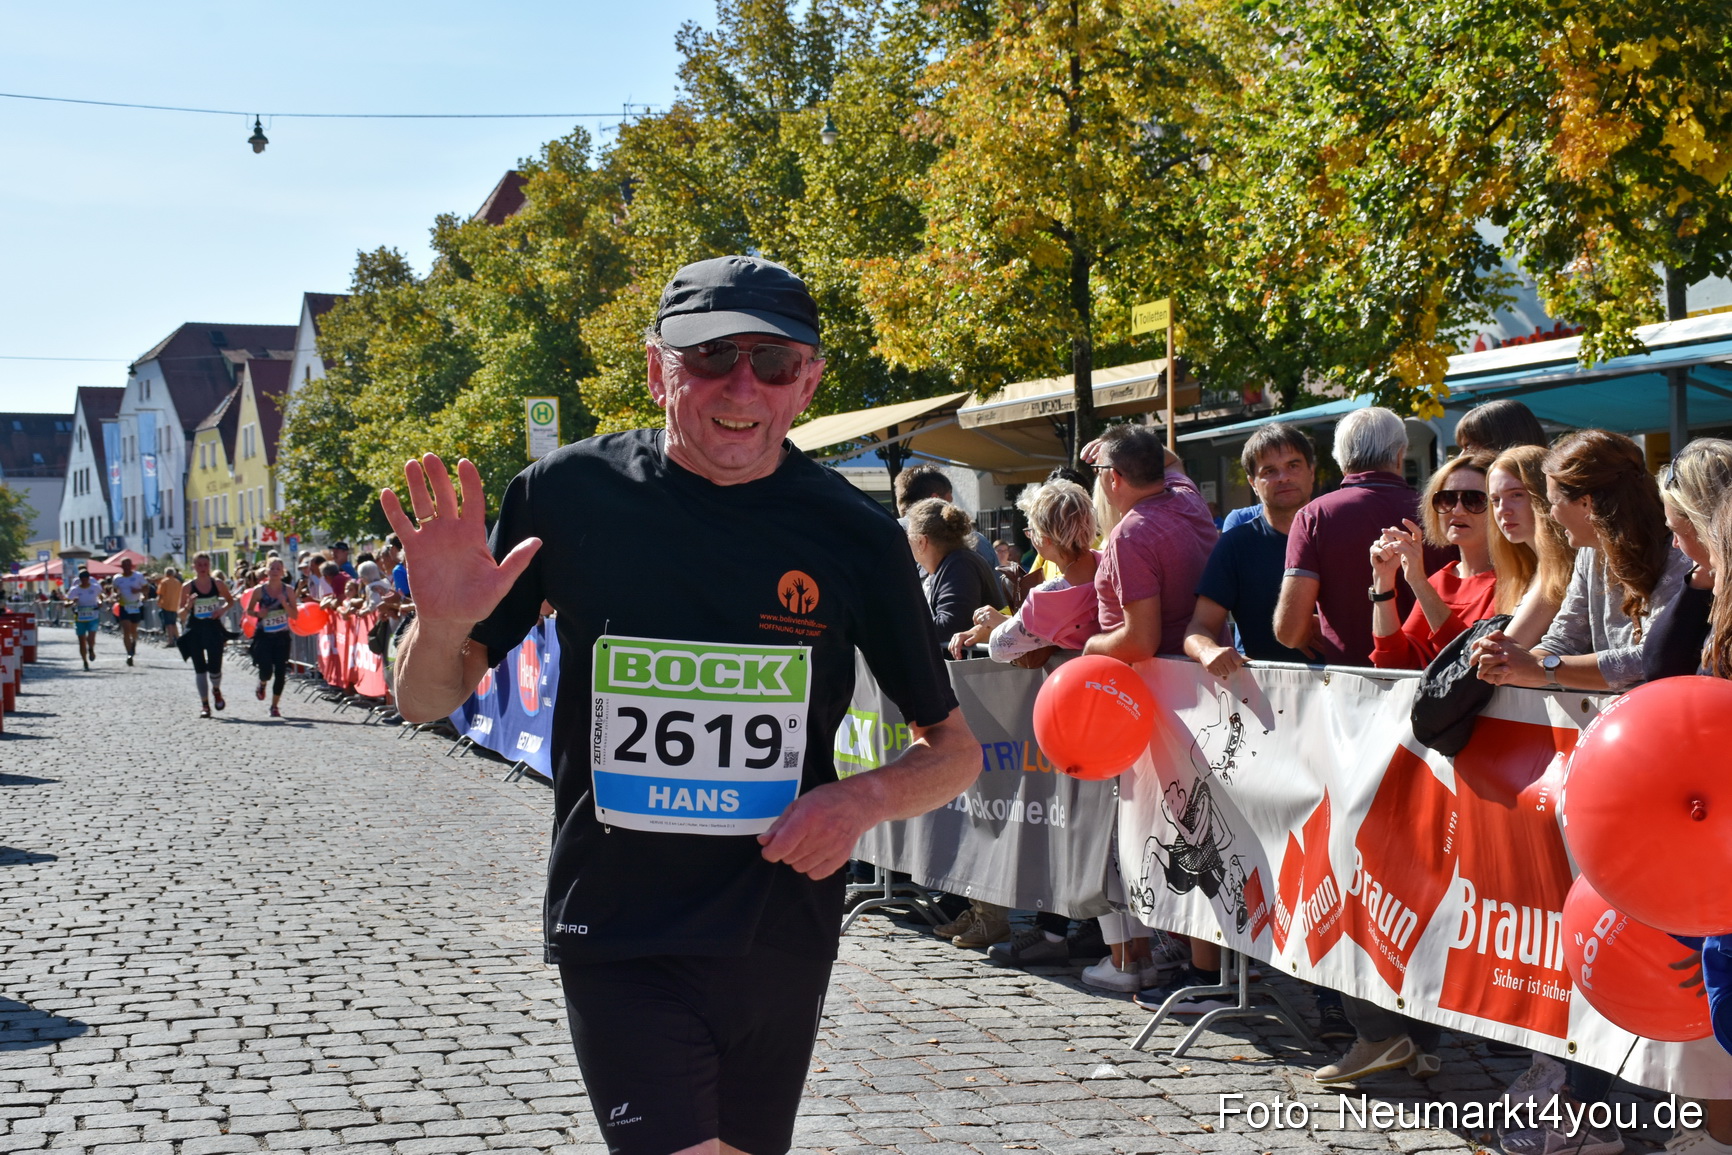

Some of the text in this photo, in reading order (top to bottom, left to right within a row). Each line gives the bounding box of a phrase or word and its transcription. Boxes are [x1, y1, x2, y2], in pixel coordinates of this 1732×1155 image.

[1139, 310, 1168, 325] Toiletten
[536, 407, 549, 420] H
[609, 646, 793, 696] BOCK
[1085, 678, 1141, 717] RÖDL
[614, 706, 782, 769] 2619
[789, 718, 797, 729] D
[648, 785, 740, 813] HANS
[1536, 786, 1550, 811] Seit
[1444, 811, 1458, 855] Seit 1929
[1301, 875, 1338, 939] Braun
[1349, 846, 1418, 951] Braun
[556, 923, 588, 934] SPIRO
[1449, 876, 1564, 972] Braun
[1606, 916, 1629, 946] ener
[1574, 909, 1617, 990] RÖD
[1493, 967, 1525, 991] Sicher
[1527, 976, 1541, 995] ist
[616, 1116, 642, 1125] TOUCH
